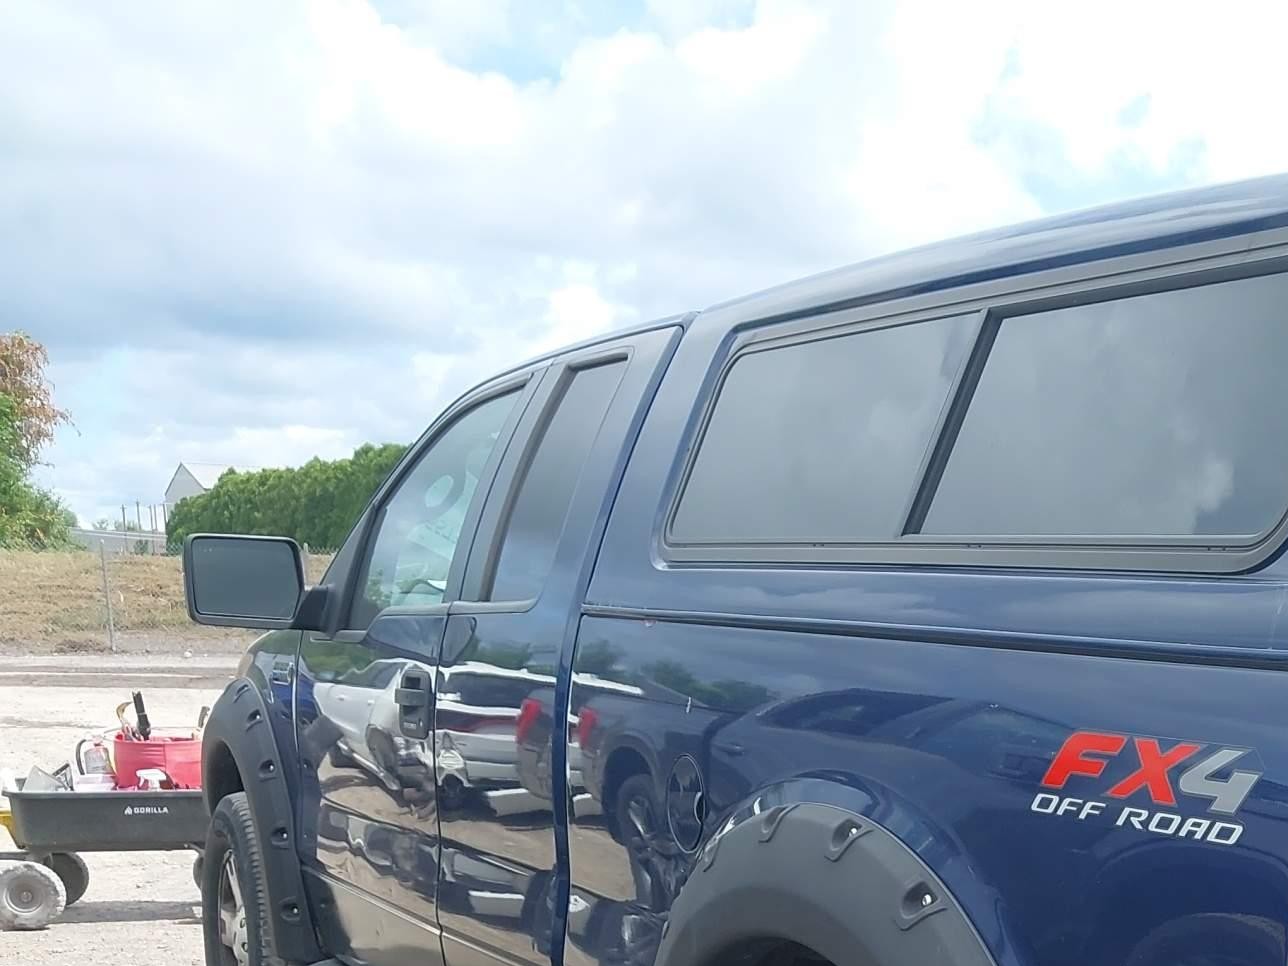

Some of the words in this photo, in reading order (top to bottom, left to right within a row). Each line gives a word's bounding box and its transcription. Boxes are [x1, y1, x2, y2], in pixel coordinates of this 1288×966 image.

[1040, 731, 1261, 815] FX4
[133, 806, 169, 815] GORILLA
[1030, 792, 1107, 821] OFF
[1115, 806, 1245, 846] ROAD
